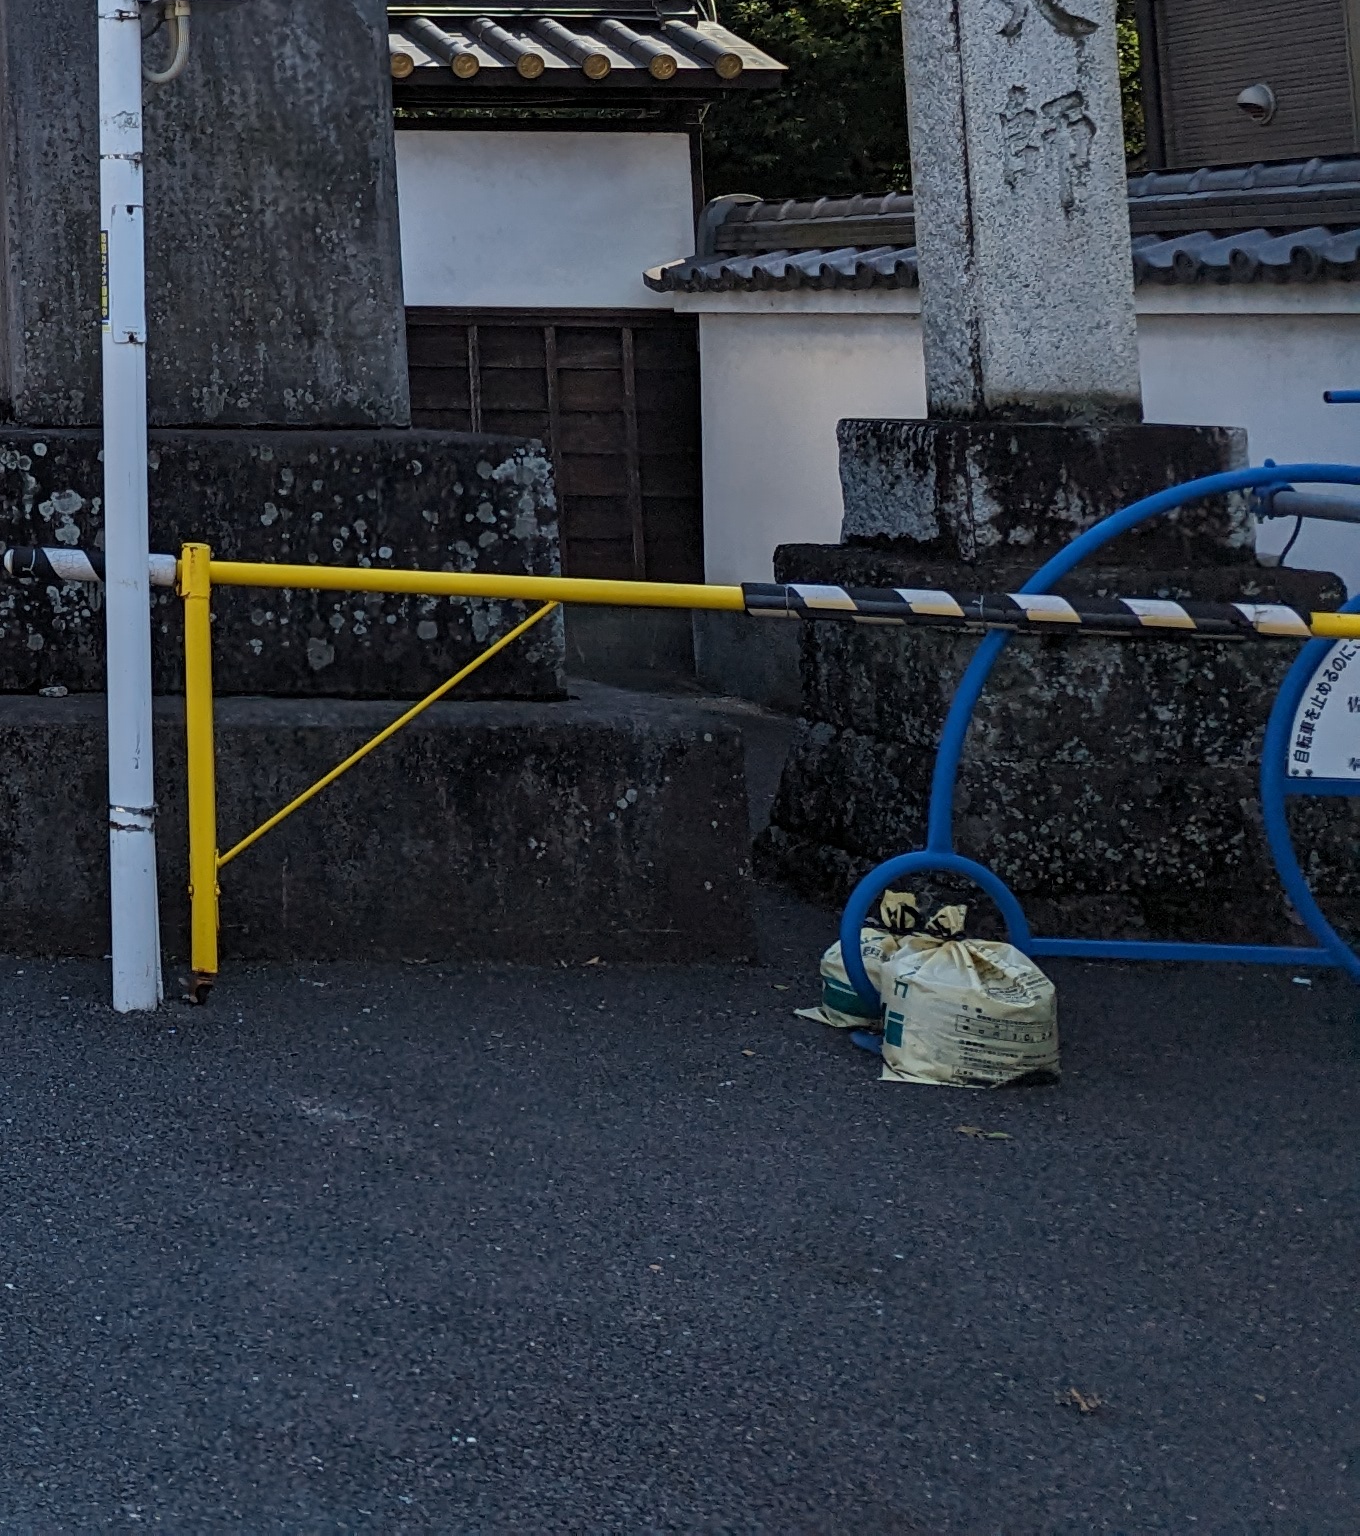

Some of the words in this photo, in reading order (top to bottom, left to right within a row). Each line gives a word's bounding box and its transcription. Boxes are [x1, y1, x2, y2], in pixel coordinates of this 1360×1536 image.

[1293, 639, 1360, 763] 自転車を止めるのに
